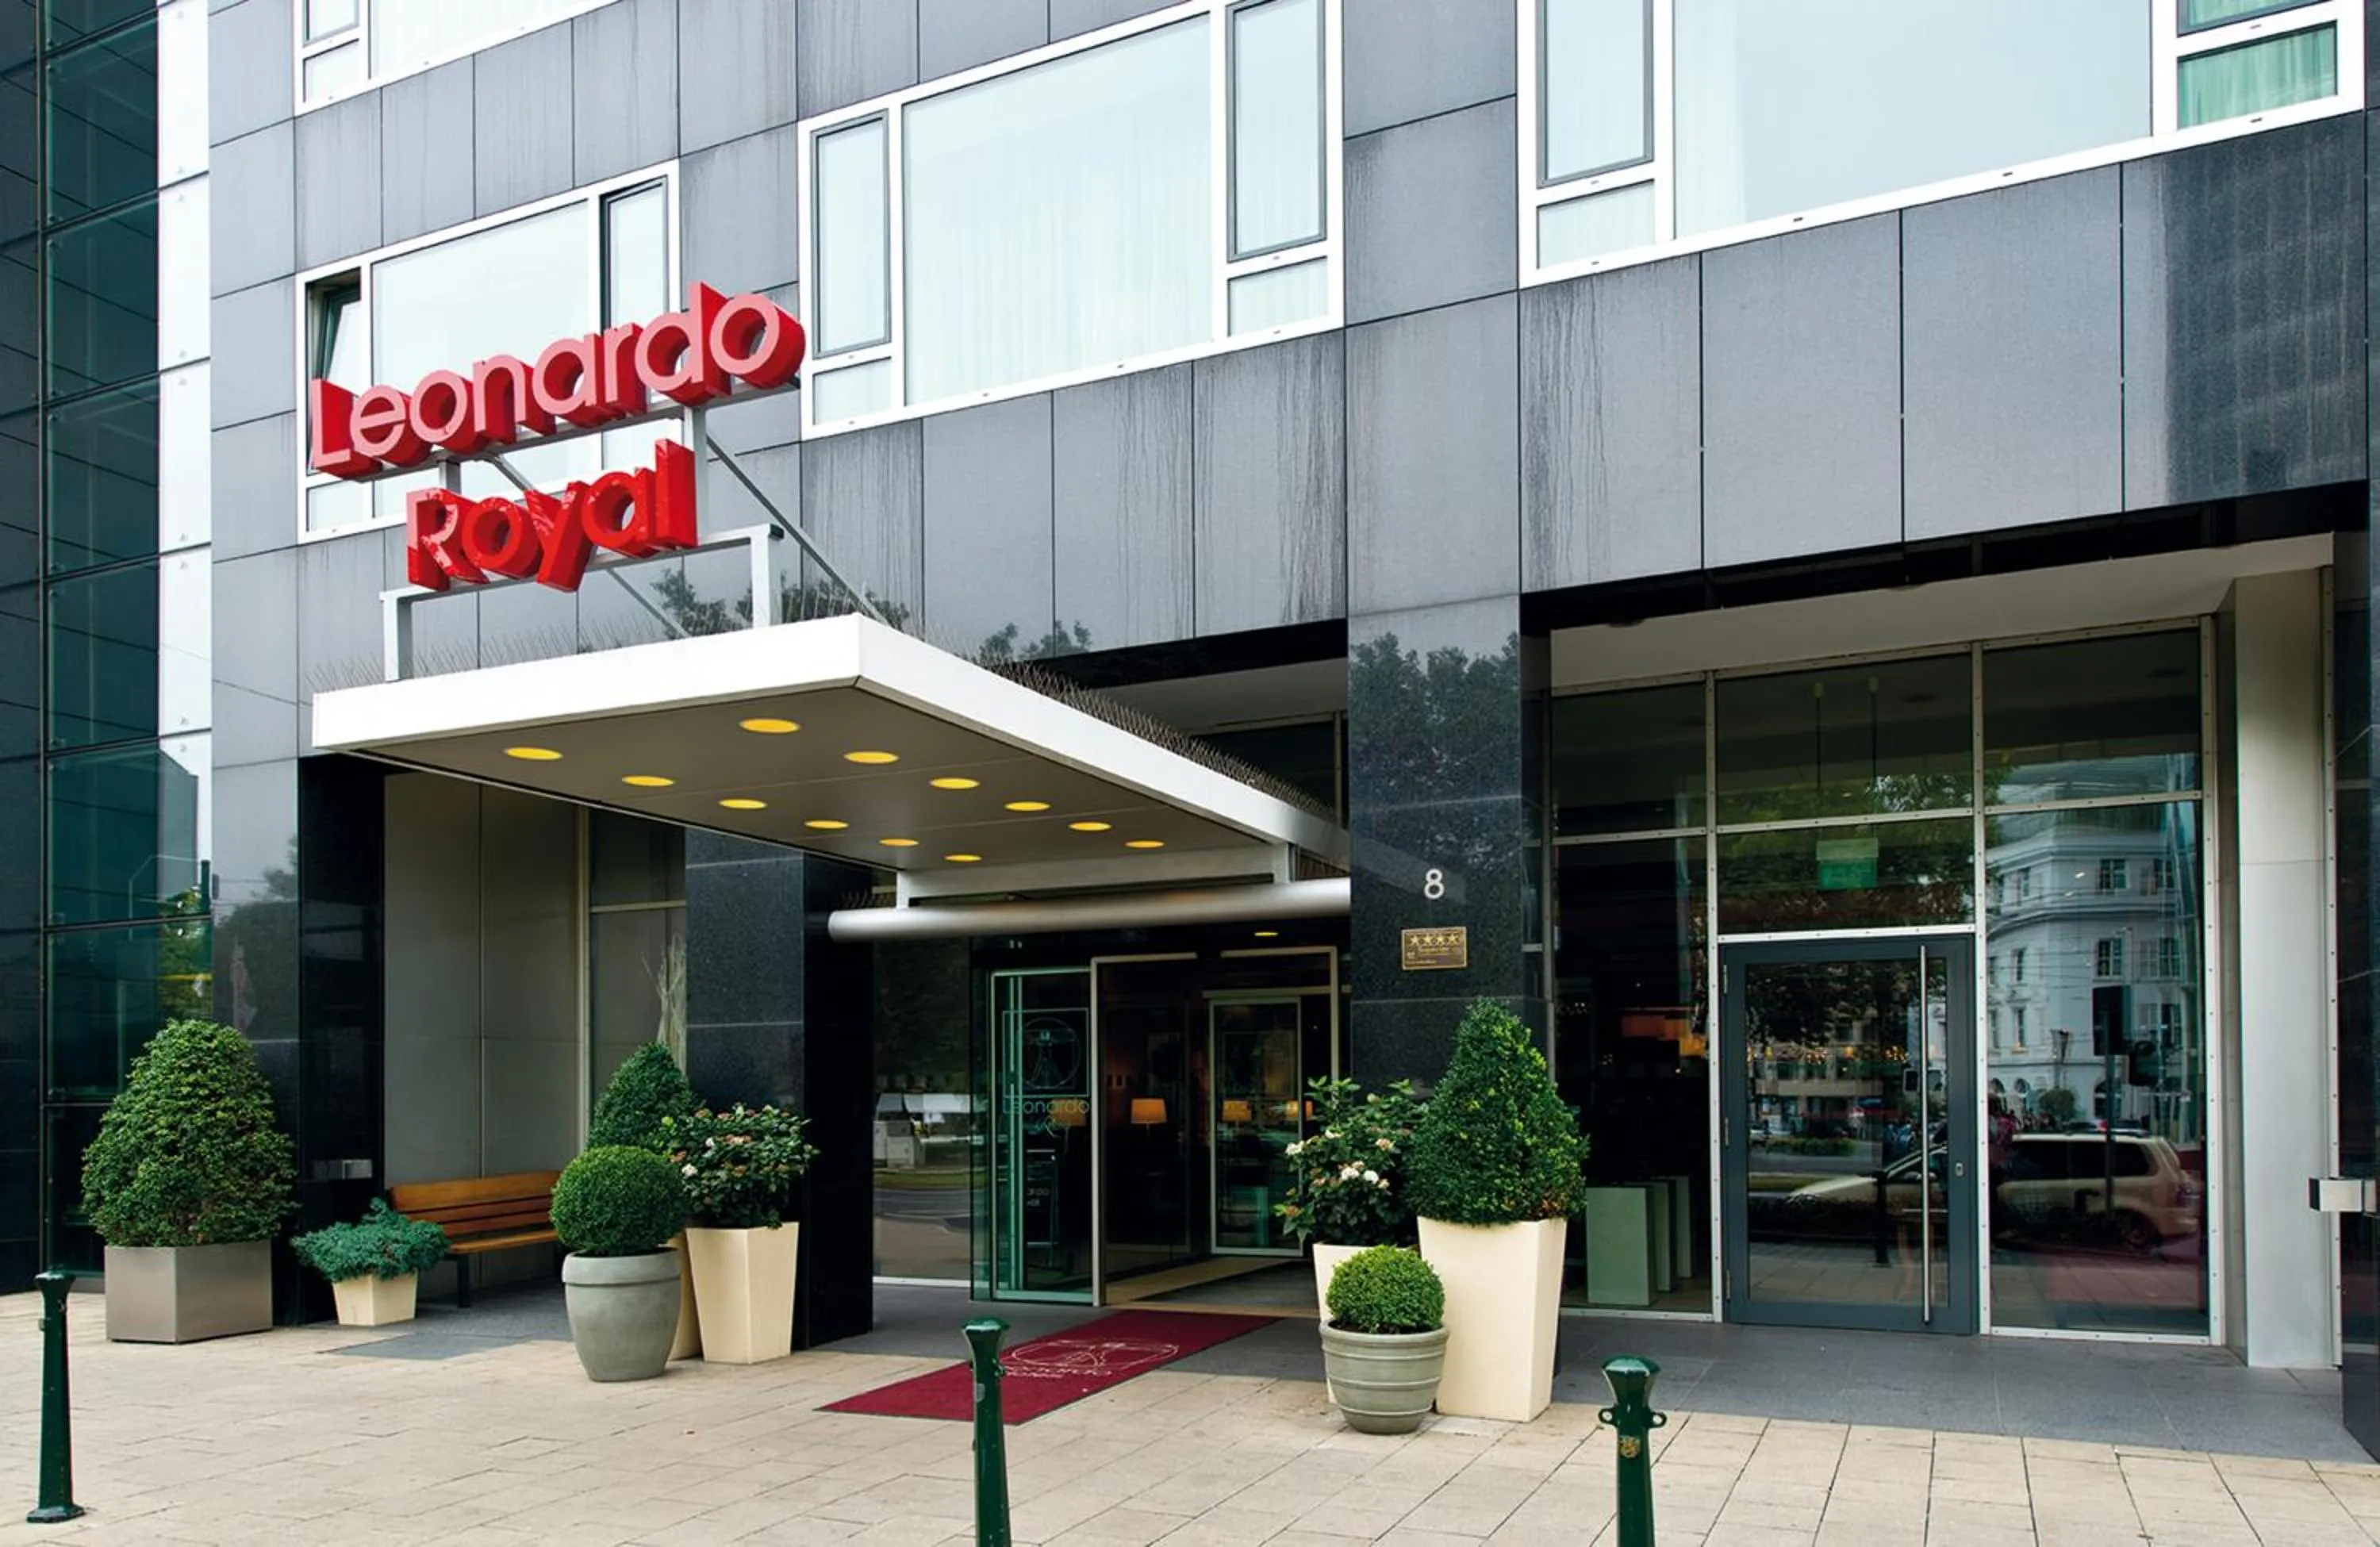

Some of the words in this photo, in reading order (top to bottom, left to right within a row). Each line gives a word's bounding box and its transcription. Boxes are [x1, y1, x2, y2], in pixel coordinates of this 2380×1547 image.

[310, 281, 806, 480] Leonardo
[405, 438, 697, 593] Royal
[1423, 868, 1445, 900] 8
